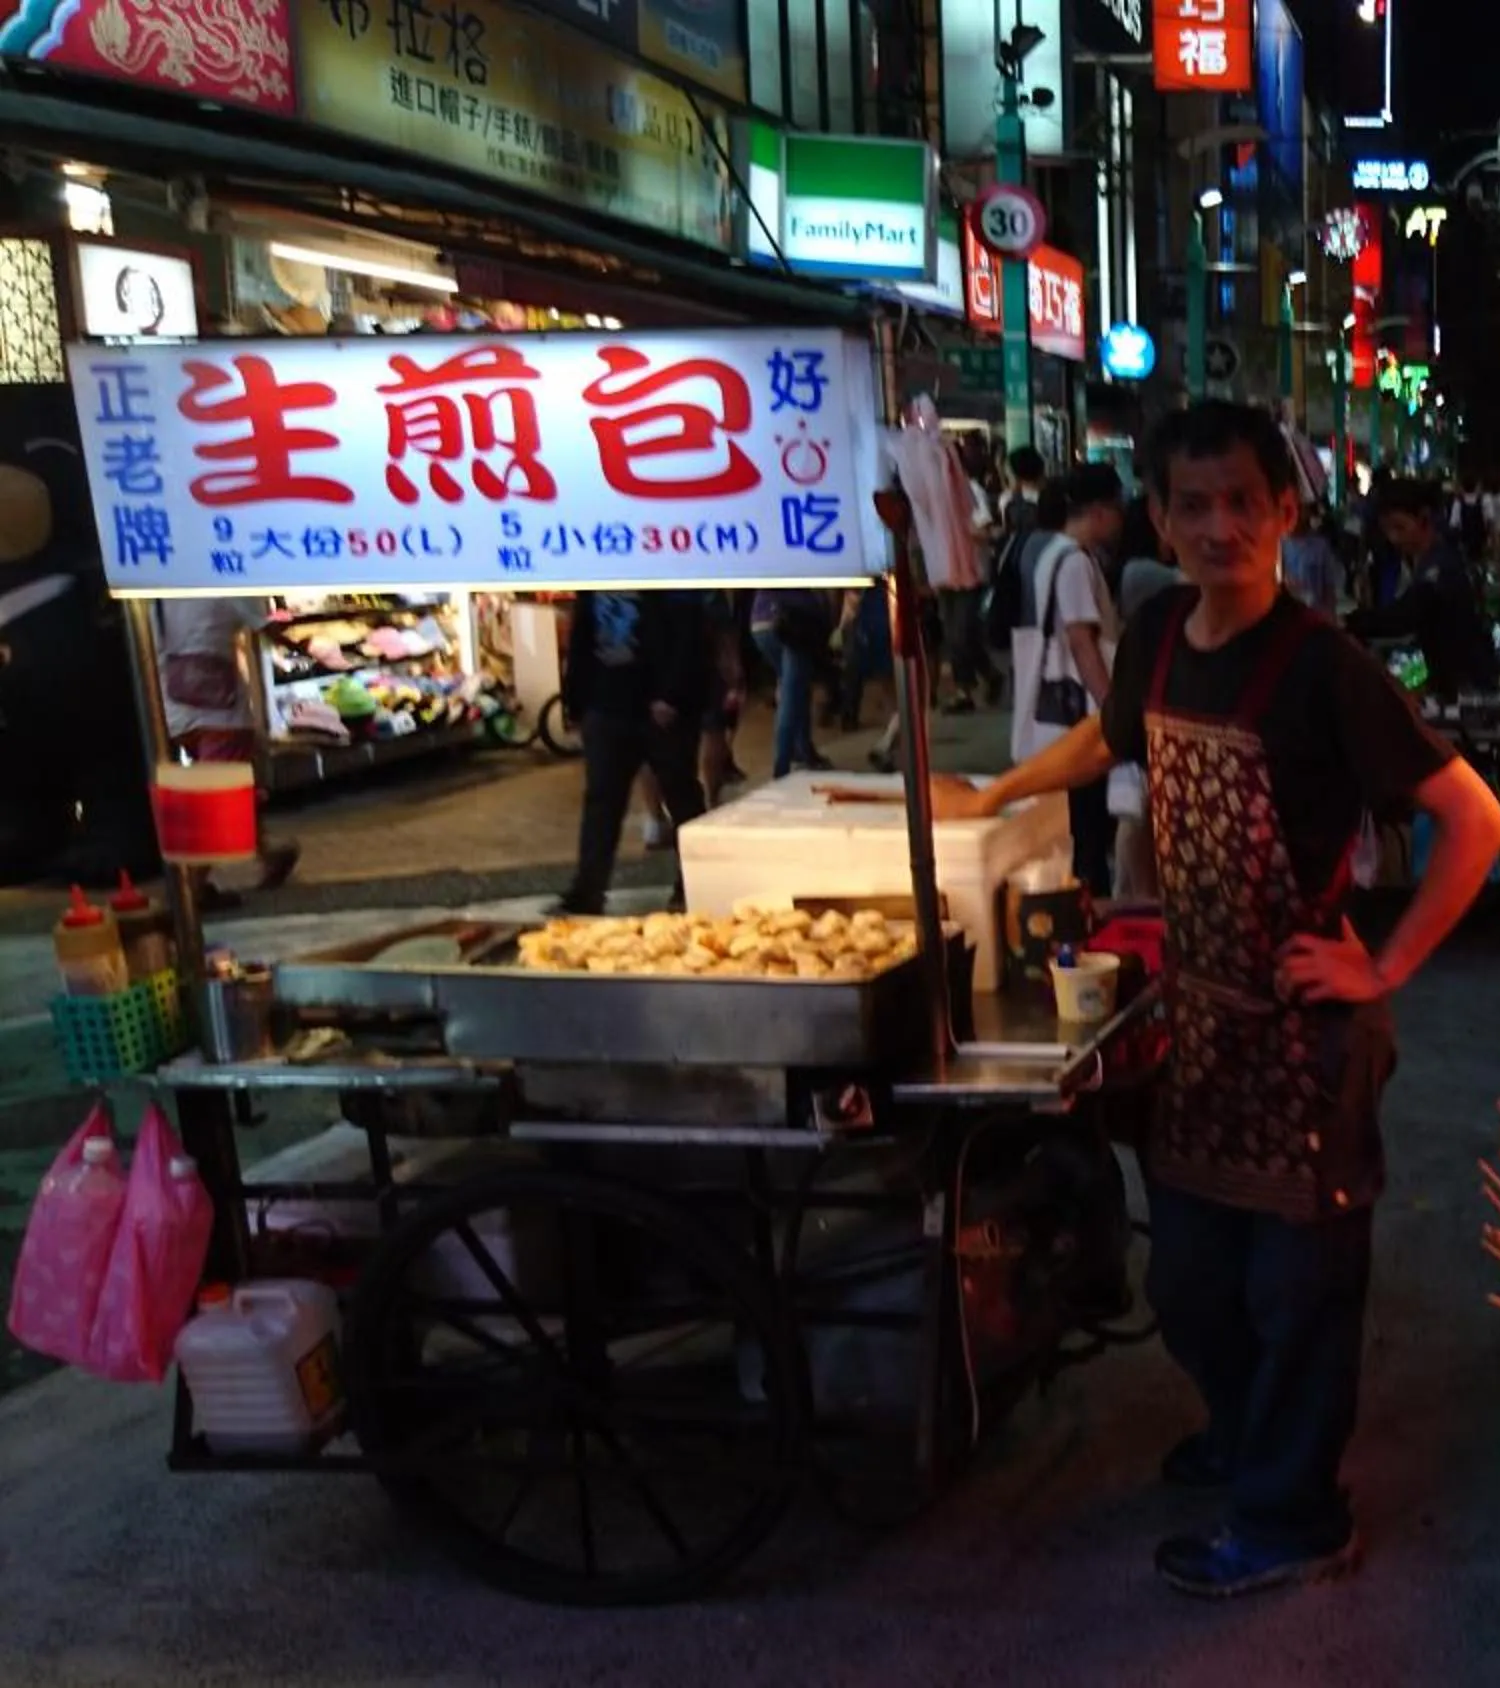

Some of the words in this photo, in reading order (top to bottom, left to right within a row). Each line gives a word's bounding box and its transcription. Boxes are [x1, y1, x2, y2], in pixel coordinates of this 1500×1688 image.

[790, 214, 918, 246] FamilyMart
[989, 207, 1029, 237] 30
[89, 363, 176, 568] 正老牌
[177, 343, 763, 508] 生煎包
